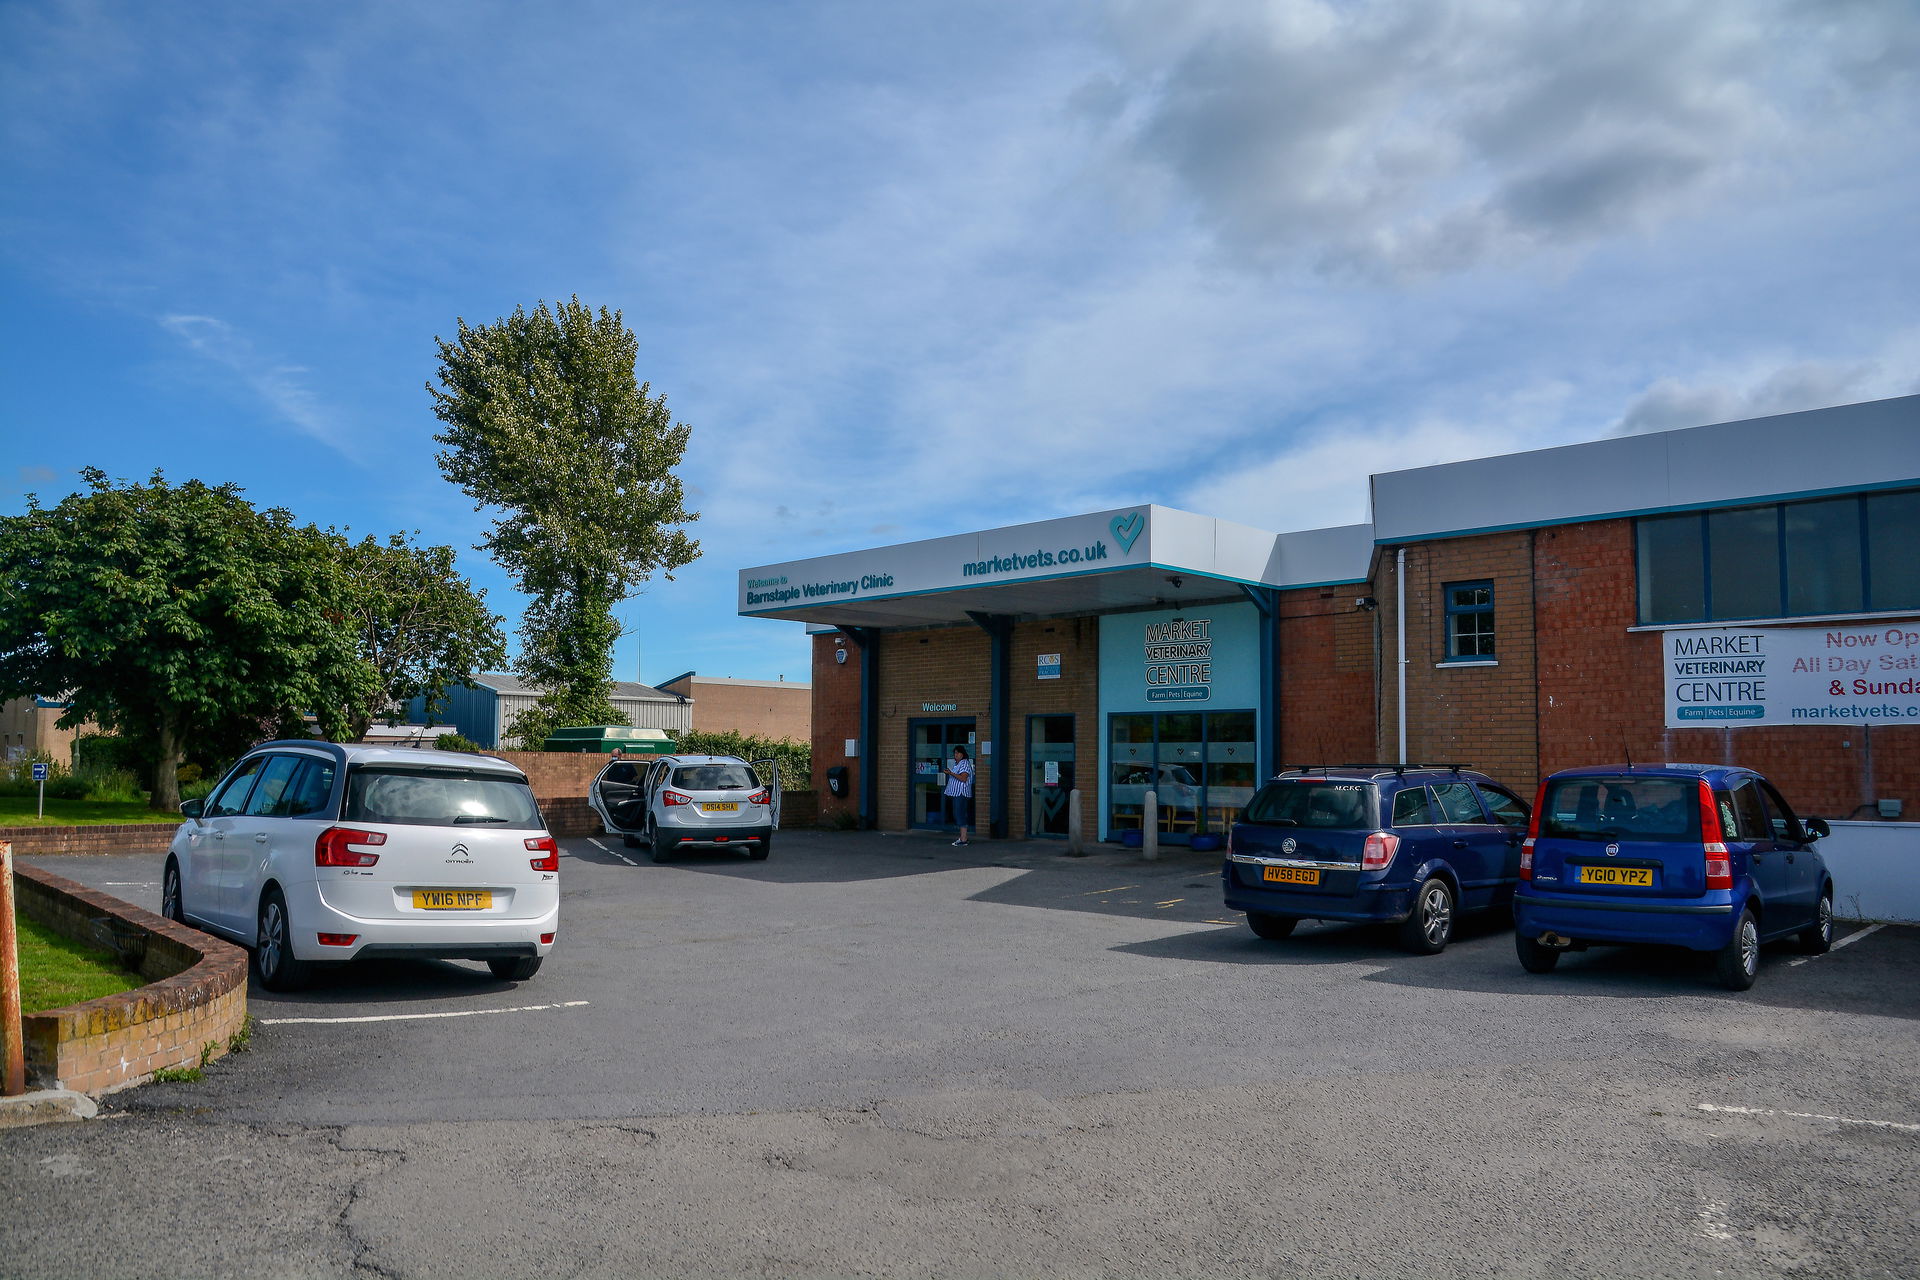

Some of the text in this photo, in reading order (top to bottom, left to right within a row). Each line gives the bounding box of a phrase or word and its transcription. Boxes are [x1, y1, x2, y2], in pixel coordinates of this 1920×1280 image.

[963, 540, 1108, 577] marketvets.co.uk
[746, 572, 894, 605] Barnstaple Veterinary Clinic
[747, 575, 788, 589] Welcome to
[1145, 619, 1211, 642] MARKET
[1675, 635, 1765, 656] MARKET
[1826, 632, 1878, 649] Now
[1144, 642, 1212, 660] VETERINARY
[1674, 660, 1766, 676] VETERINARY
[1792, 654, 1920, 675] All Day Sat
[1145, 663, 1211, 686] CENTRE
[1183, 690, 1203, 699] Equine
[1675, 681, 1766, 703] CENTRE
[1828, 679, 1846, 696] &
[922, 702, 957, 712] Welcome
[1684, 707, 1756, 718] Farm Pets Equine
[1791, 704, 1920, 719] marketvets.c
[1267, 869, 1316, 882] HV58 EGD
[1586, 868, 1647, 884] YG10 YPZ
[422, 892, 483, 906] YW16 NPF
